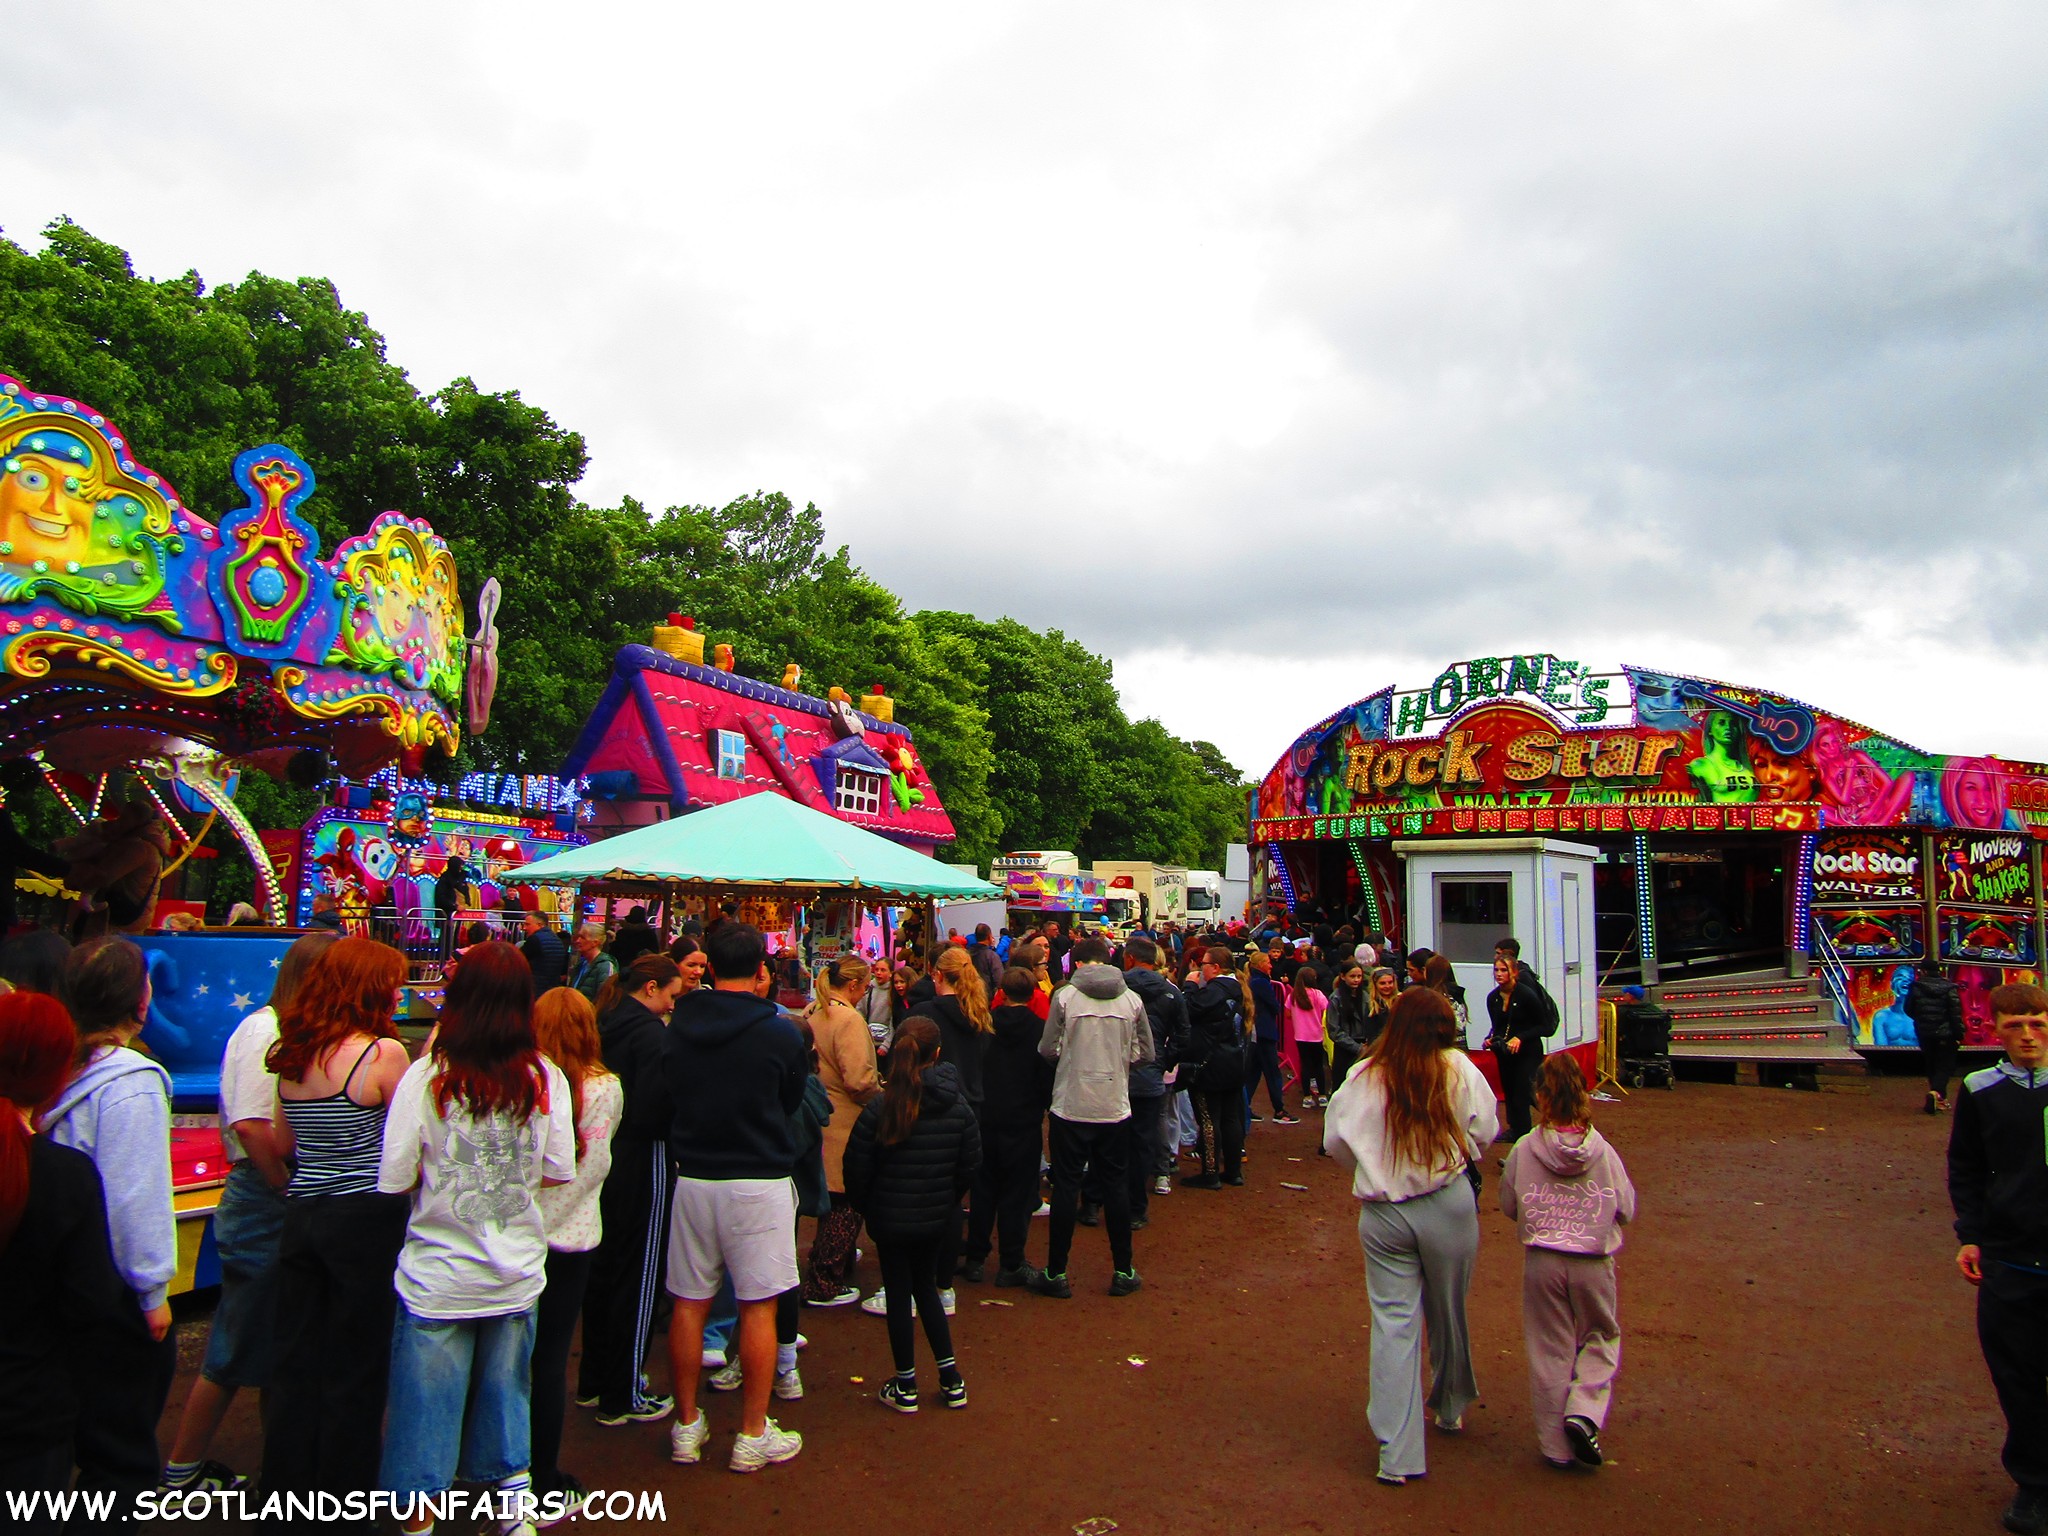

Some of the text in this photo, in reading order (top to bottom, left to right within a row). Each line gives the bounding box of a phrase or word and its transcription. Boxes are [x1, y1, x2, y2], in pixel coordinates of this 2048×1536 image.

[1394, 653, 1610, 737] HORNE'S
[1503, 731, 1685, 784] Star
[457, 771, 560, 812] MIAMI
[1454, 790, 1553, 808] WALTZ
[1452, 807, 1775, 833] UNBELIEVABLE
[1867, 851, 1919, 875] Star
[1970, 836, 2021, 865] MOVERS
[1985, 857, 2005, 874] AND
[1813, 881, 1915, 897] WALTZER
[1972, 863, 2030, 902] SHAKERS
[1522, 1182, 1594, 1209] Have a
[1535, 1216, 1571, 1238] day
